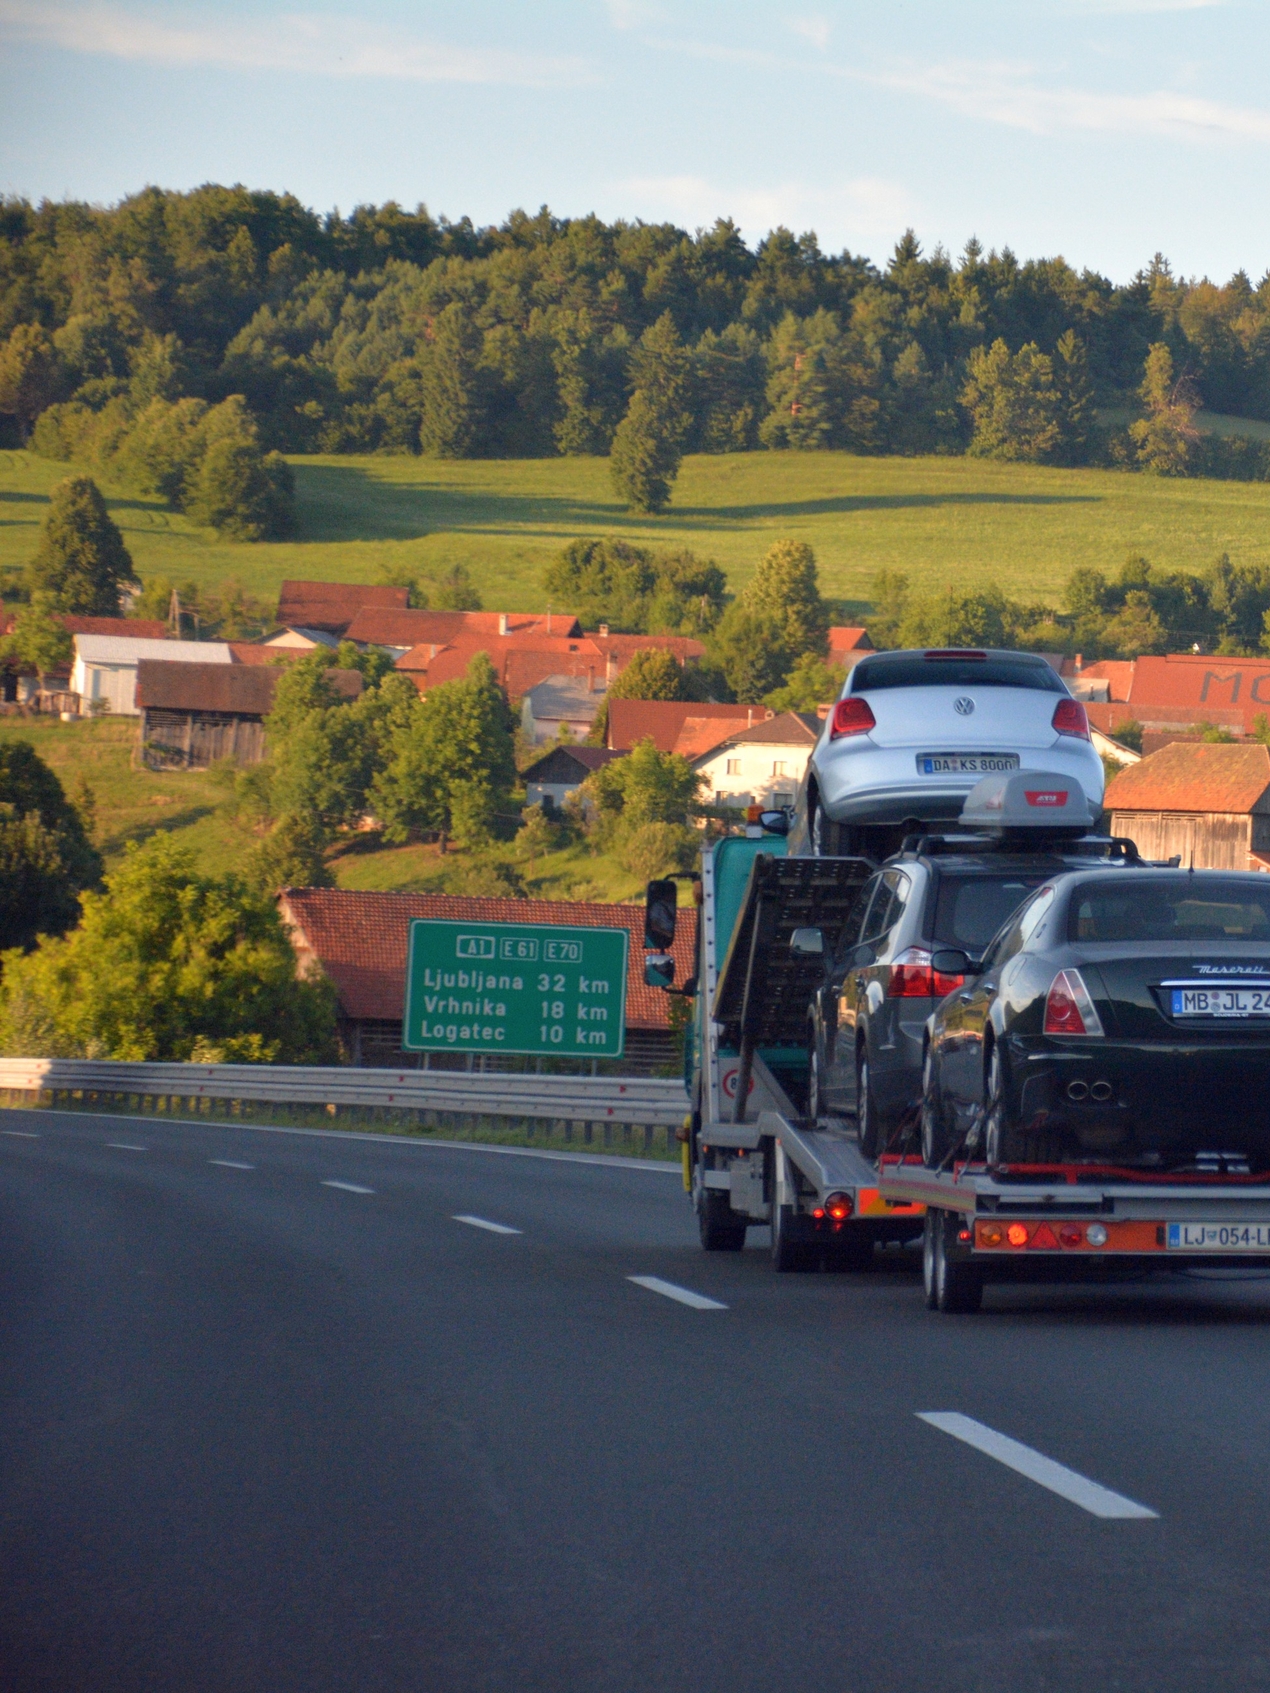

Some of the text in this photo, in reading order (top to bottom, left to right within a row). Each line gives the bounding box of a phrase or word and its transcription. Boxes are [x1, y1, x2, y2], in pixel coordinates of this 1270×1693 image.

[933, 760, 950, 771] DA
[960, 760, 977, 771] KS
[467, 939, 485, 955] A1
[504, 941, 534, 957] E 61
[548, 943, 578, 959] E 70
[1192, 965, 1270, 975] Maserati
[424, 968, 609, 994] Ljubljana 32 km
[424, 996, 607, 1020] Vrhnika 18 km
[1184, 993, 1209, 1010] MB
[1223, 993, 1247, 1010] JL
[421, 1020, 606, 1044] Logatec 10 km
[1184, 1227, 1205, 1246] LJ
